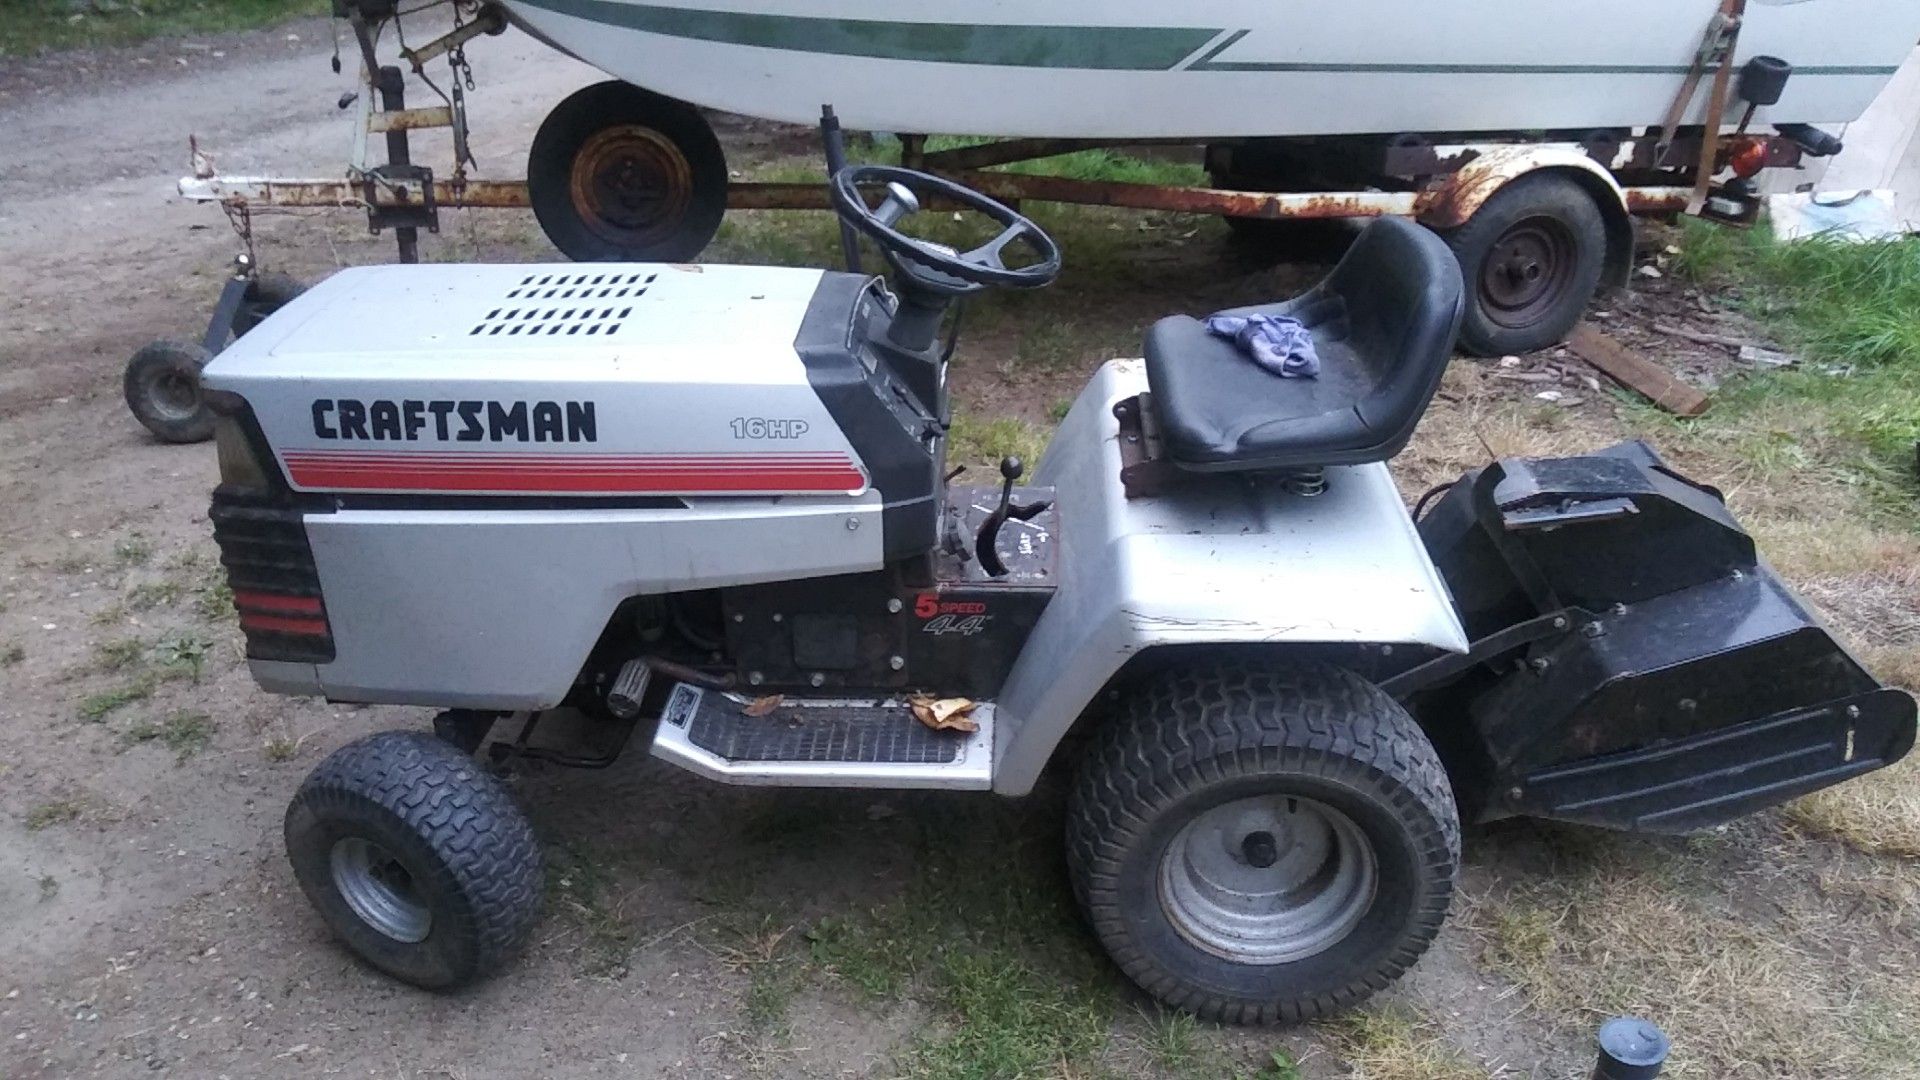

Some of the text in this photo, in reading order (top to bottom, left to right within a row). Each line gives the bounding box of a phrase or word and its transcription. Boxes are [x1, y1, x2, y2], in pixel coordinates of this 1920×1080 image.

[311, 399, 598, 443] CRAFTSMAN
[729, 417, 809, 440] 16HP
[914, 591, 986, 619] 5 SPEED
